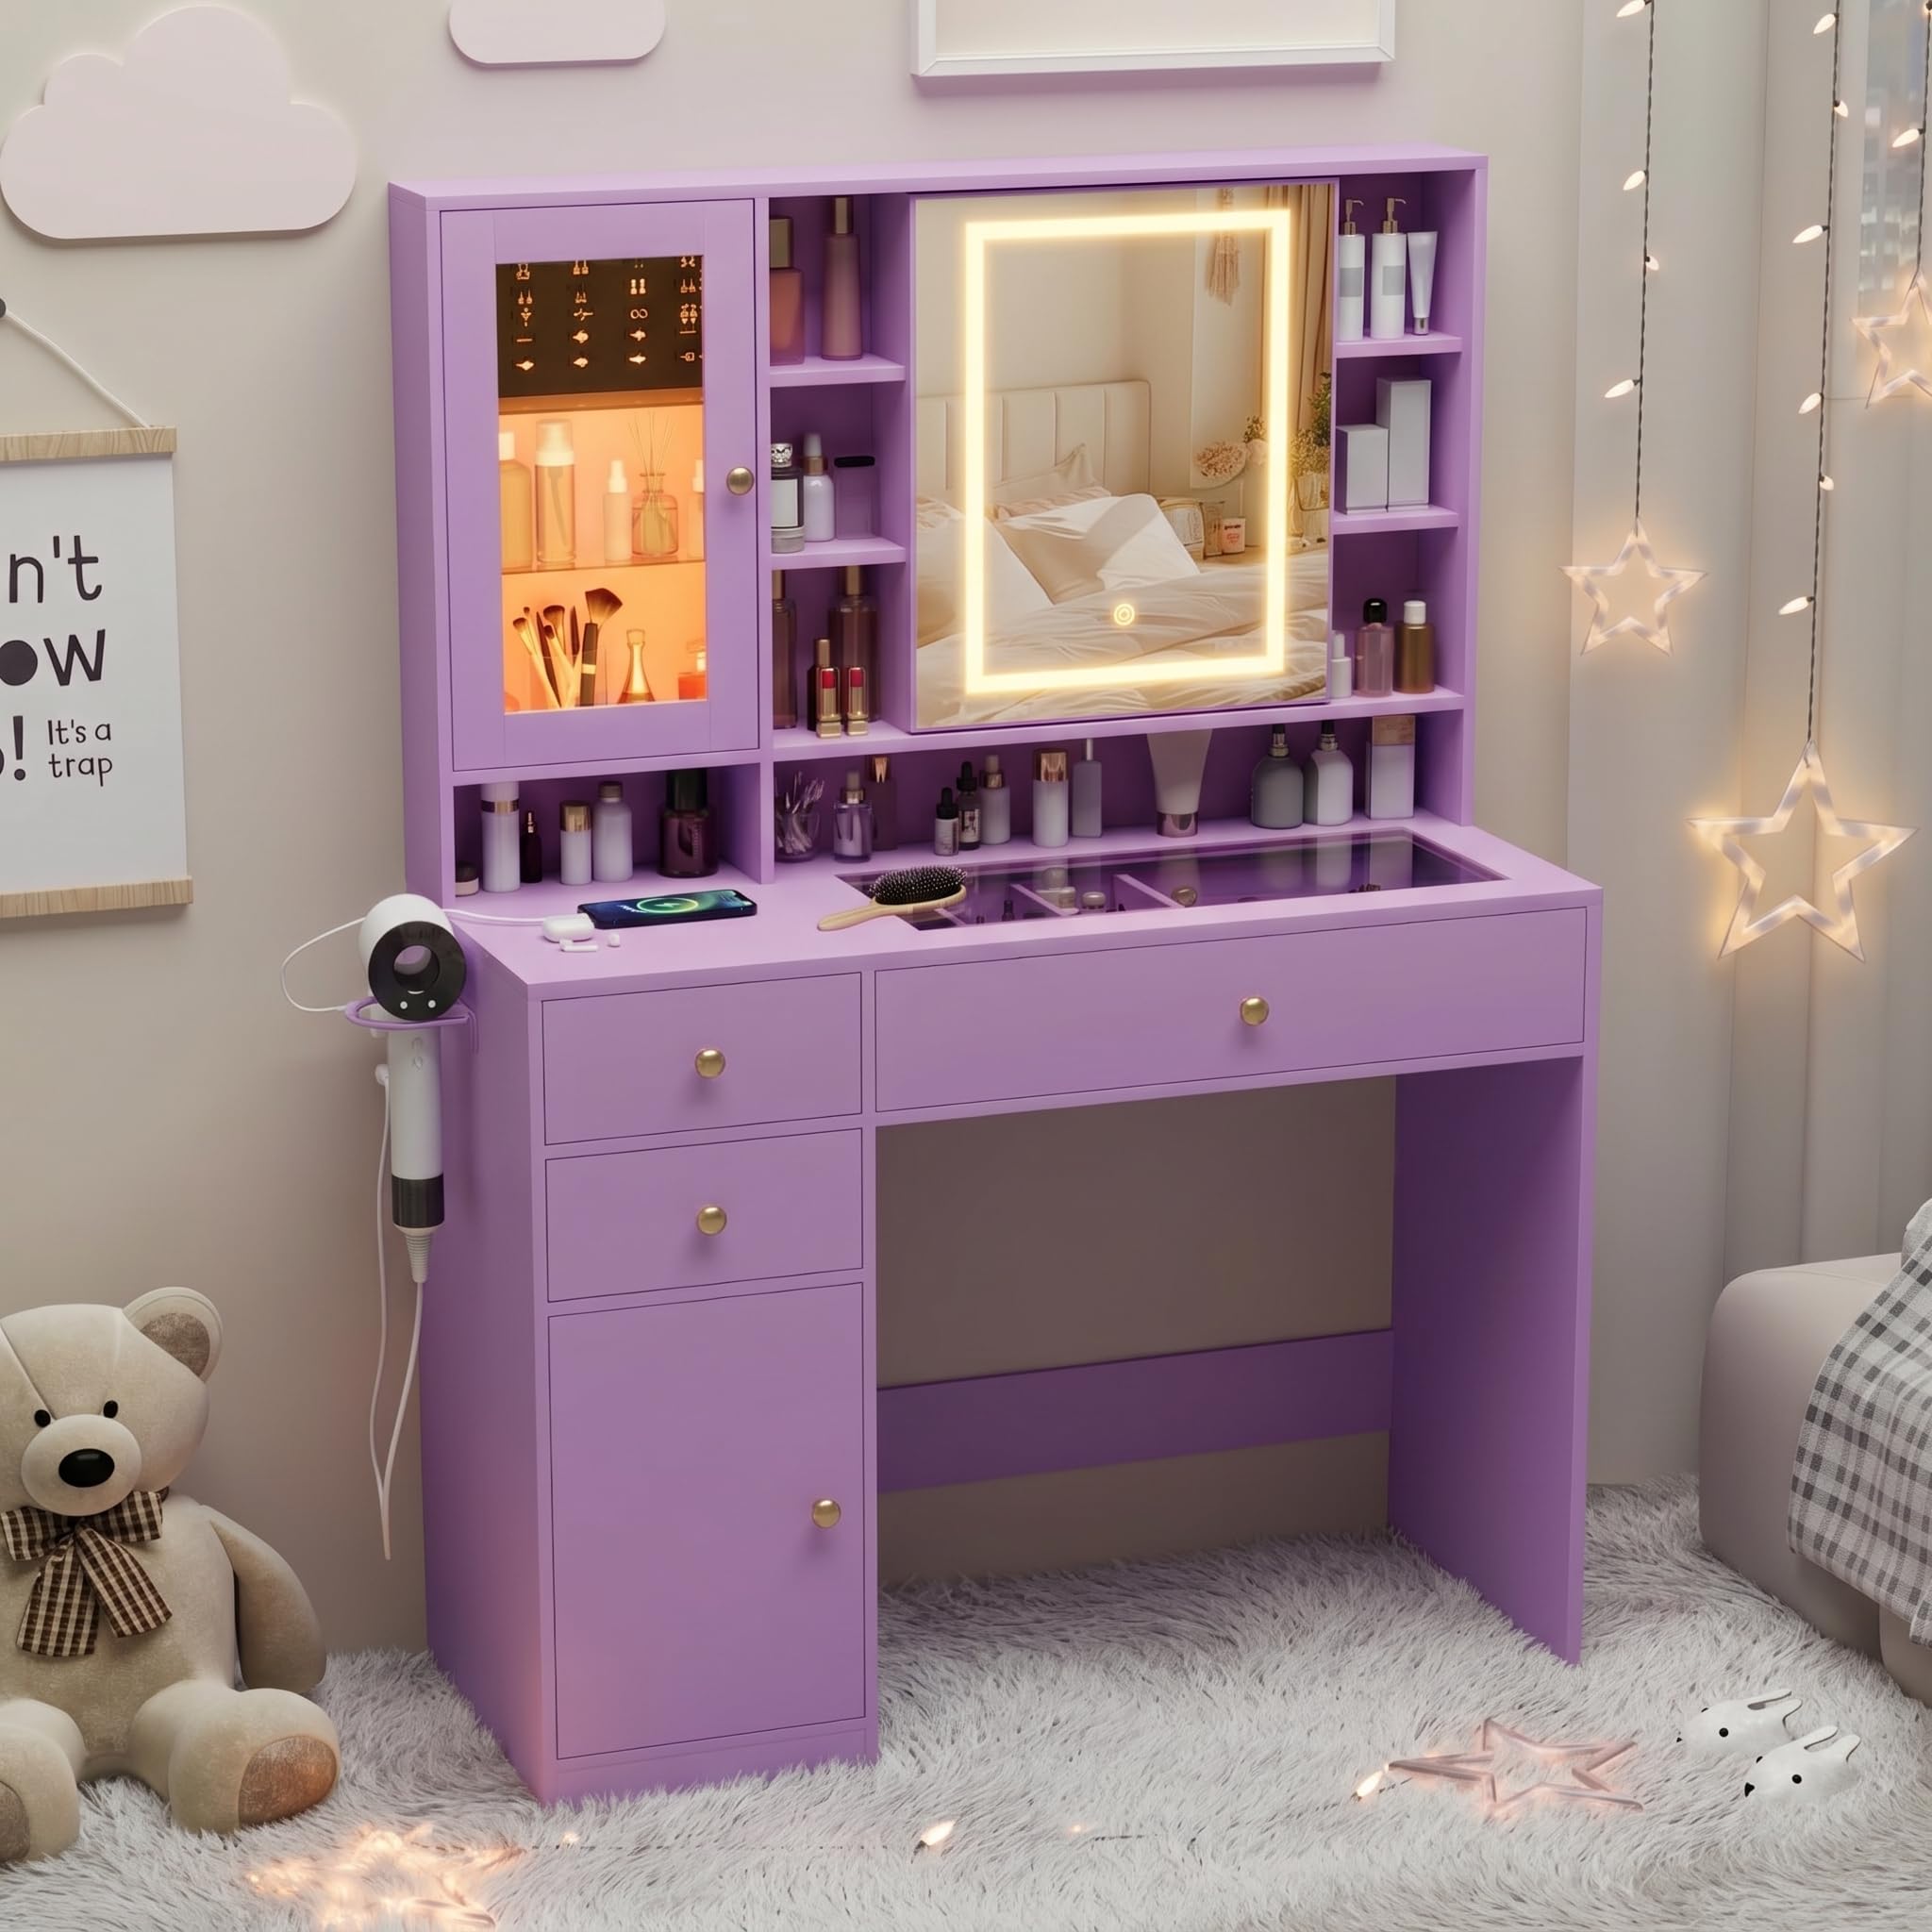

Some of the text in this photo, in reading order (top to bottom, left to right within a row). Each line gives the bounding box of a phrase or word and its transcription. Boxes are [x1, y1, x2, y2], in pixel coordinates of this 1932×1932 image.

[47, 719, 112, 745] It's a
[47, 753, 113, 788] trap
